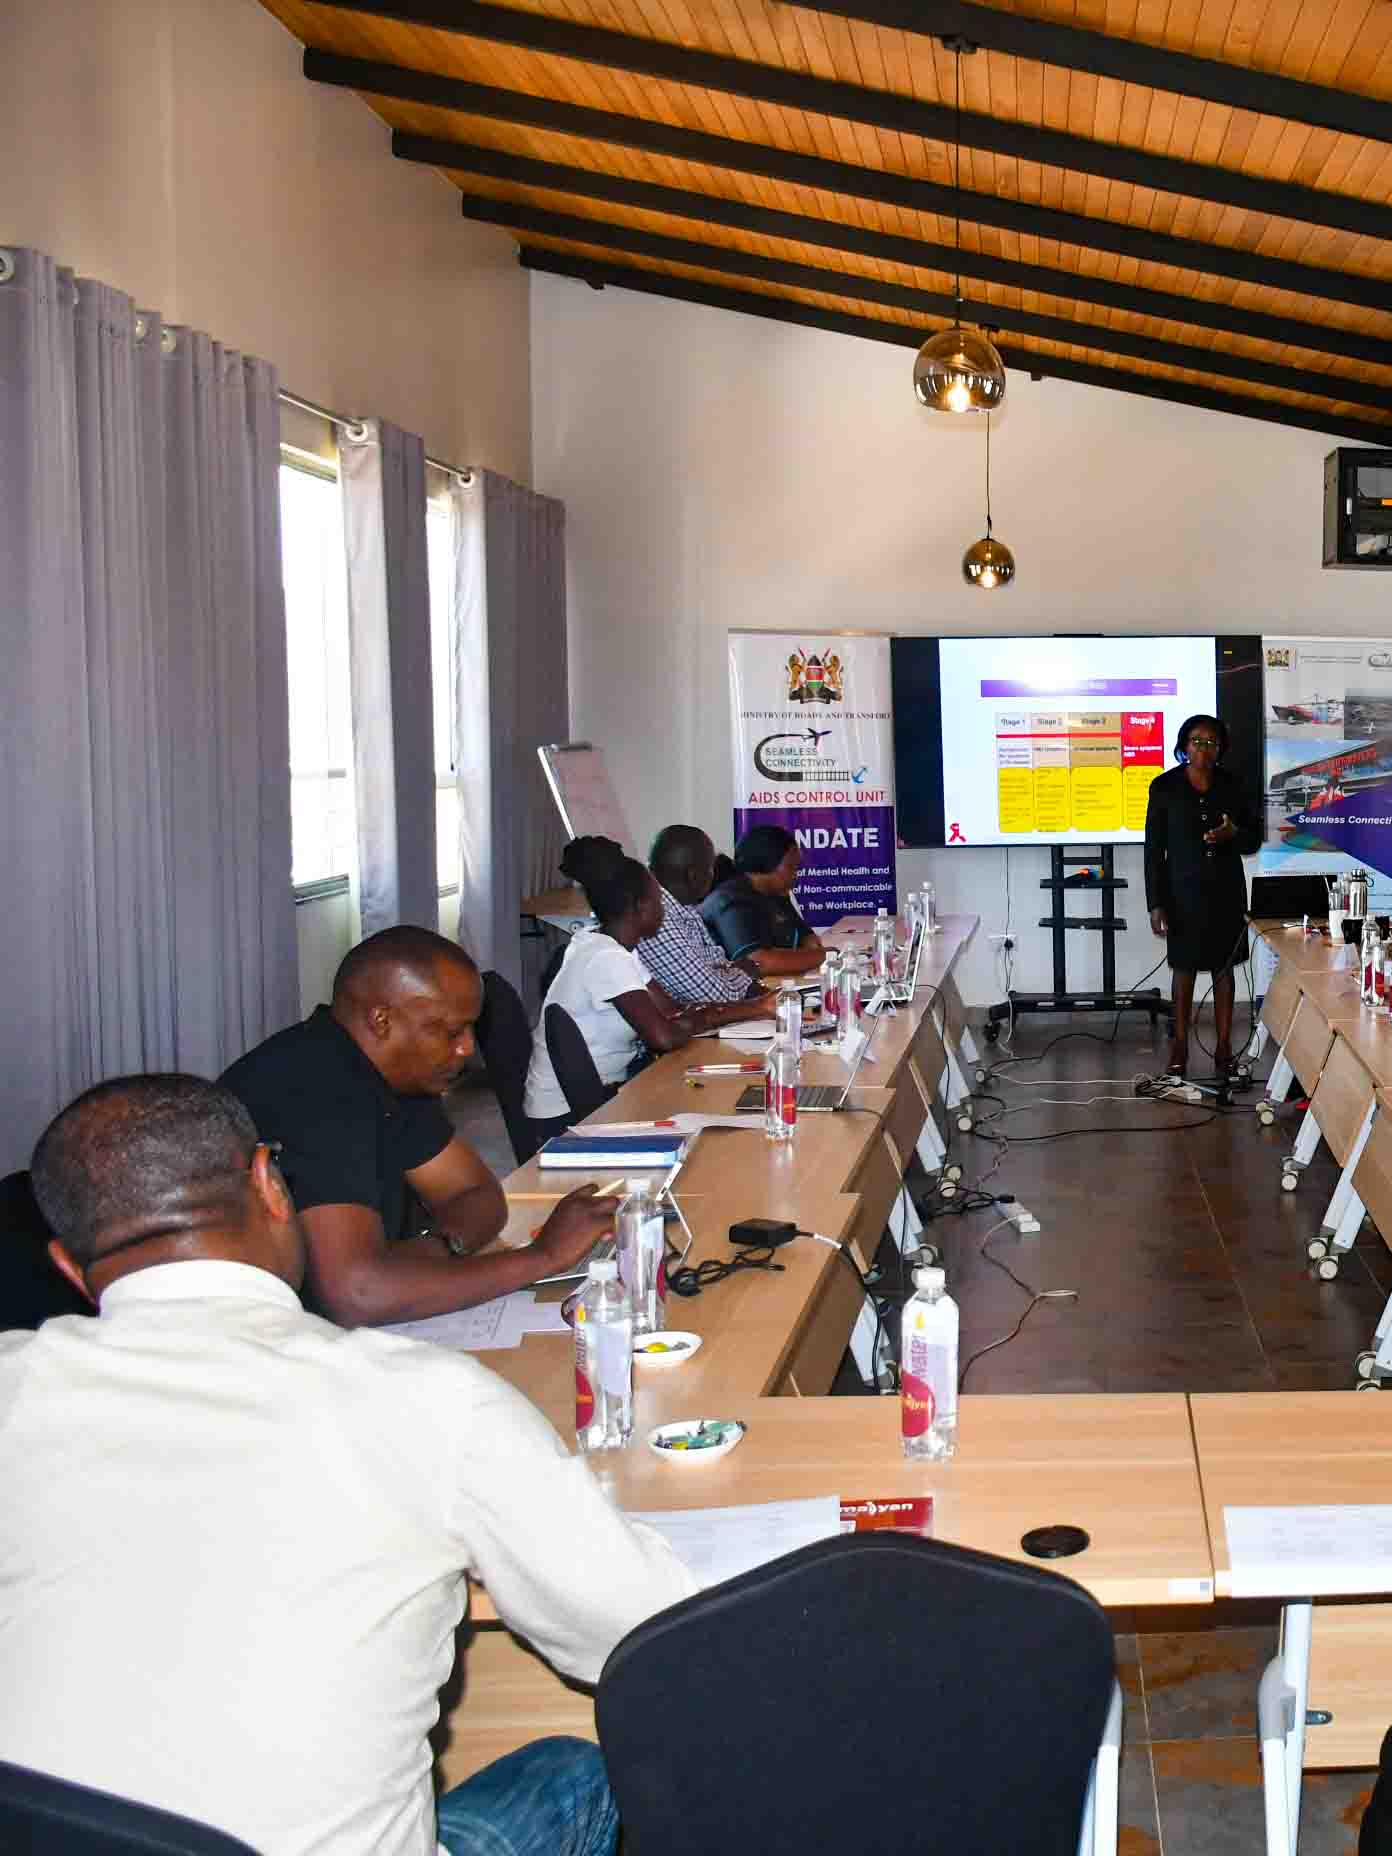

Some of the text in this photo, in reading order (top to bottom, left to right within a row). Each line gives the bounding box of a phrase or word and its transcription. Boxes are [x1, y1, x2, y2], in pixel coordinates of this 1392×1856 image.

[766, 747, 817, 756] SEAMLESS
[765, 758, 836, 768] CONNECTIVITY
[748, 791, 886, 804] AIDS CONTROL UNIT
[1298, 815, 1345, 825] Seamless
[794, 828, 880, 849] NDATE
[797, 866, 890, 877] of Mental Health and
[792, 884, 893, 894] of Non-communicable
[809, 902, 823, 911] the
